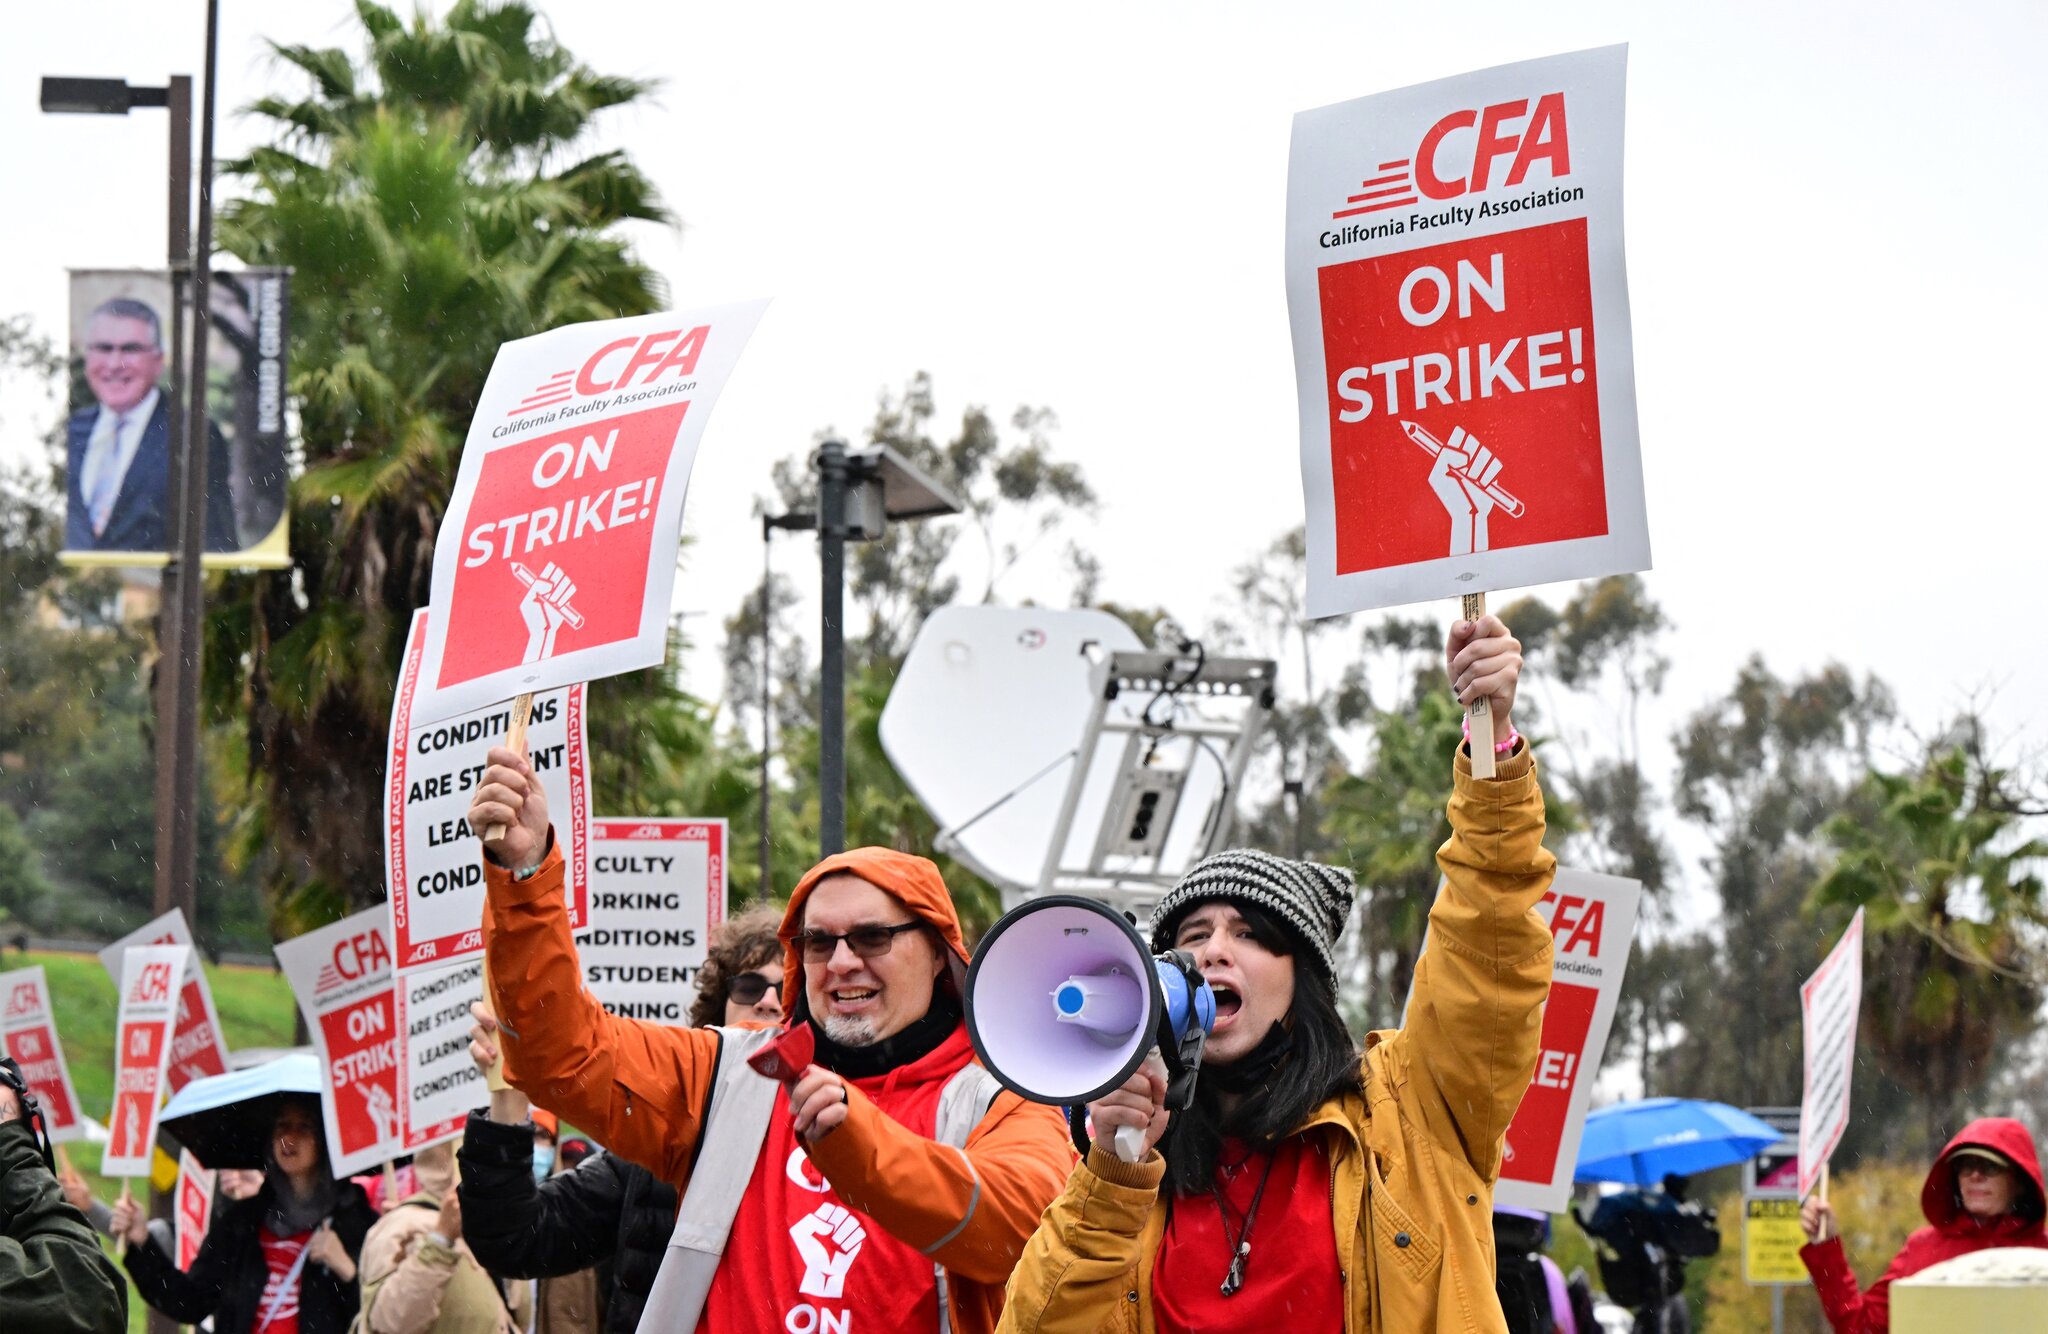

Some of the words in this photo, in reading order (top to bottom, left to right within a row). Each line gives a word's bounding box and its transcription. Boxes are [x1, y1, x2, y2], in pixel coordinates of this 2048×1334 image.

[1414, 91, 1571, 201] CFA
[1319, 218, 1405, 249] California
[1409, 205, 1475, 233] Faculty
[1478, 186, 1585, 218] Association
[1398, 252, 1506, 328] ON
[574, 324, 712, 397] CFA
[1337, 326, 1586, 424] STRIKE!
[491, 411, 557, 440] California
[558, 399, 611, 420] Faculty
[612, 381, 698, 407] Association
[531, 428, 620, 489] ON
[463, 476, 657, 569] STRIKE!
[396, 648, 421, 751] ASSOCIATION
[417, 698, 558, 755] CONDITINS
[567, 697, 583, 768] FACULTY
[391, 754, 404, 825] FACULTY
[407, 773, 453, 805] ARE
[458, 743, 566, 792] STNT
[427, 817, 478, 847] LEA
[571, 774, 585, 887] ASSOCIATION
[391, 829, 406, 929] CALIFORNIA
[417, 863, 486, 898] COND
[594, 856, 675, 873] CULTY
[333, 928, 392, 980] CFA
[416, 942, 438, 959] CFA
[461, 930, 483, 948] CFA
[575, 929, 696, 947] NDITIONS
[1540, 890, 1606, 959] FA
[1553, 960, 1604, 977] sociation
[346, 1000, 386, 1041] ON
[419, 1035, 473, 1066] LEARNIN
[332, 1039, 397, 1089] STRIK
[784, 1303, 852, 1334] ON
